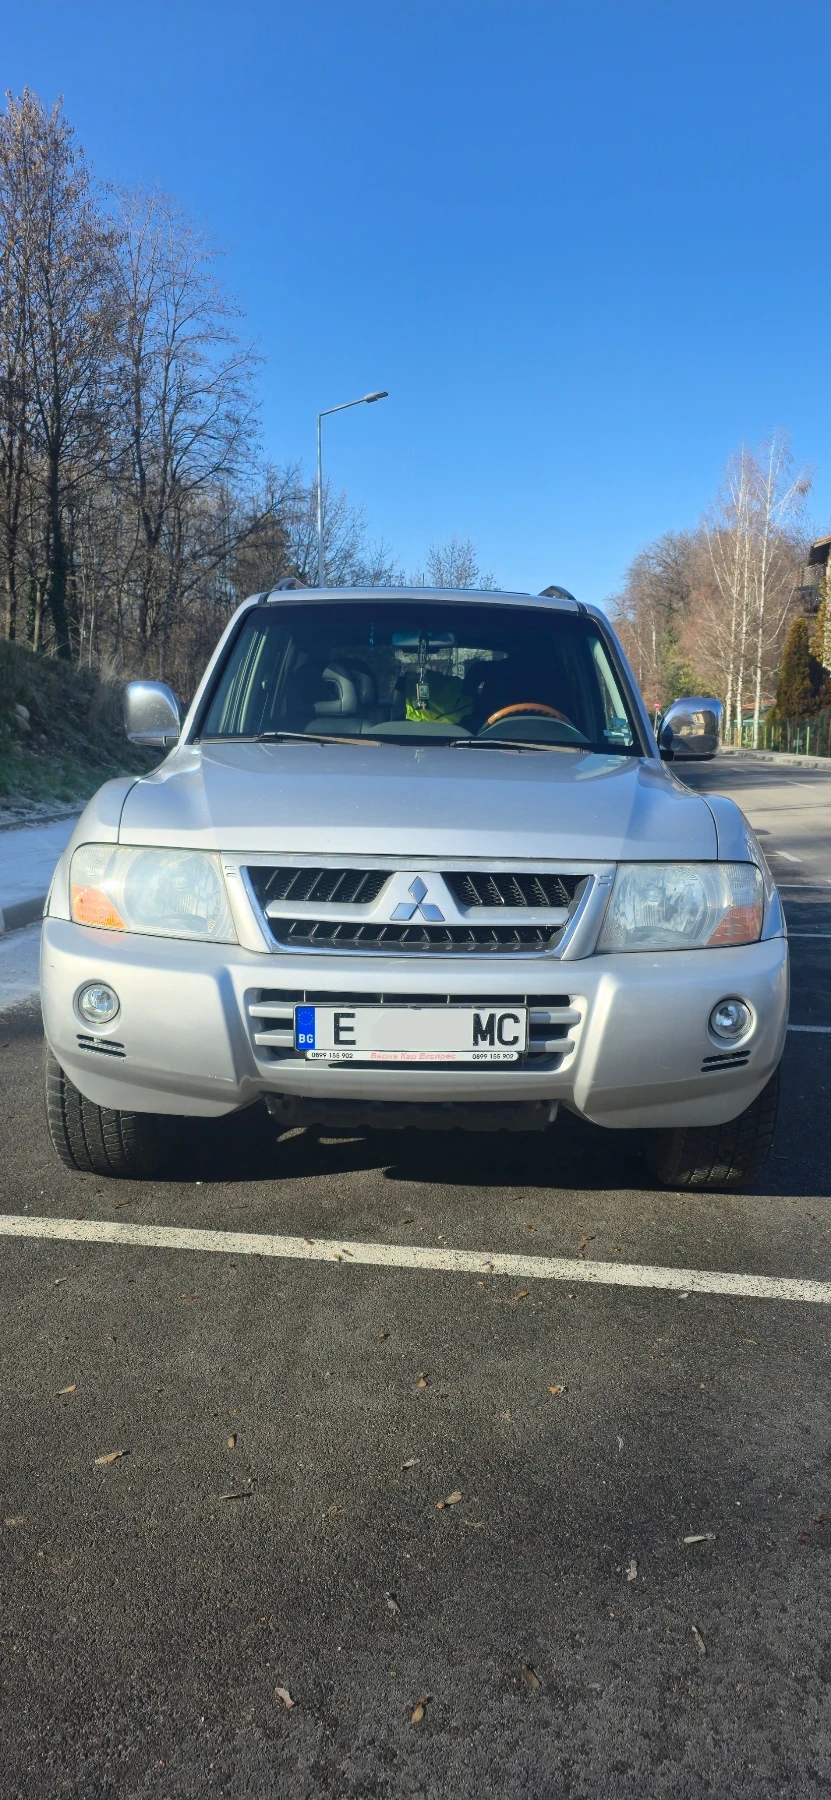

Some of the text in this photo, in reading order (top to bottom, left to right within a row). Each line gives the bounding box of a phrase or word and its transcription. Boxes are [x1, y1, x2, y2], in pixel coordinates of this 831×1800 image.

[333, 1012, 521, 1047] E MC
[298, 1034, 314, 1044] BG
[399, 1052, 417, 1060] Кар
